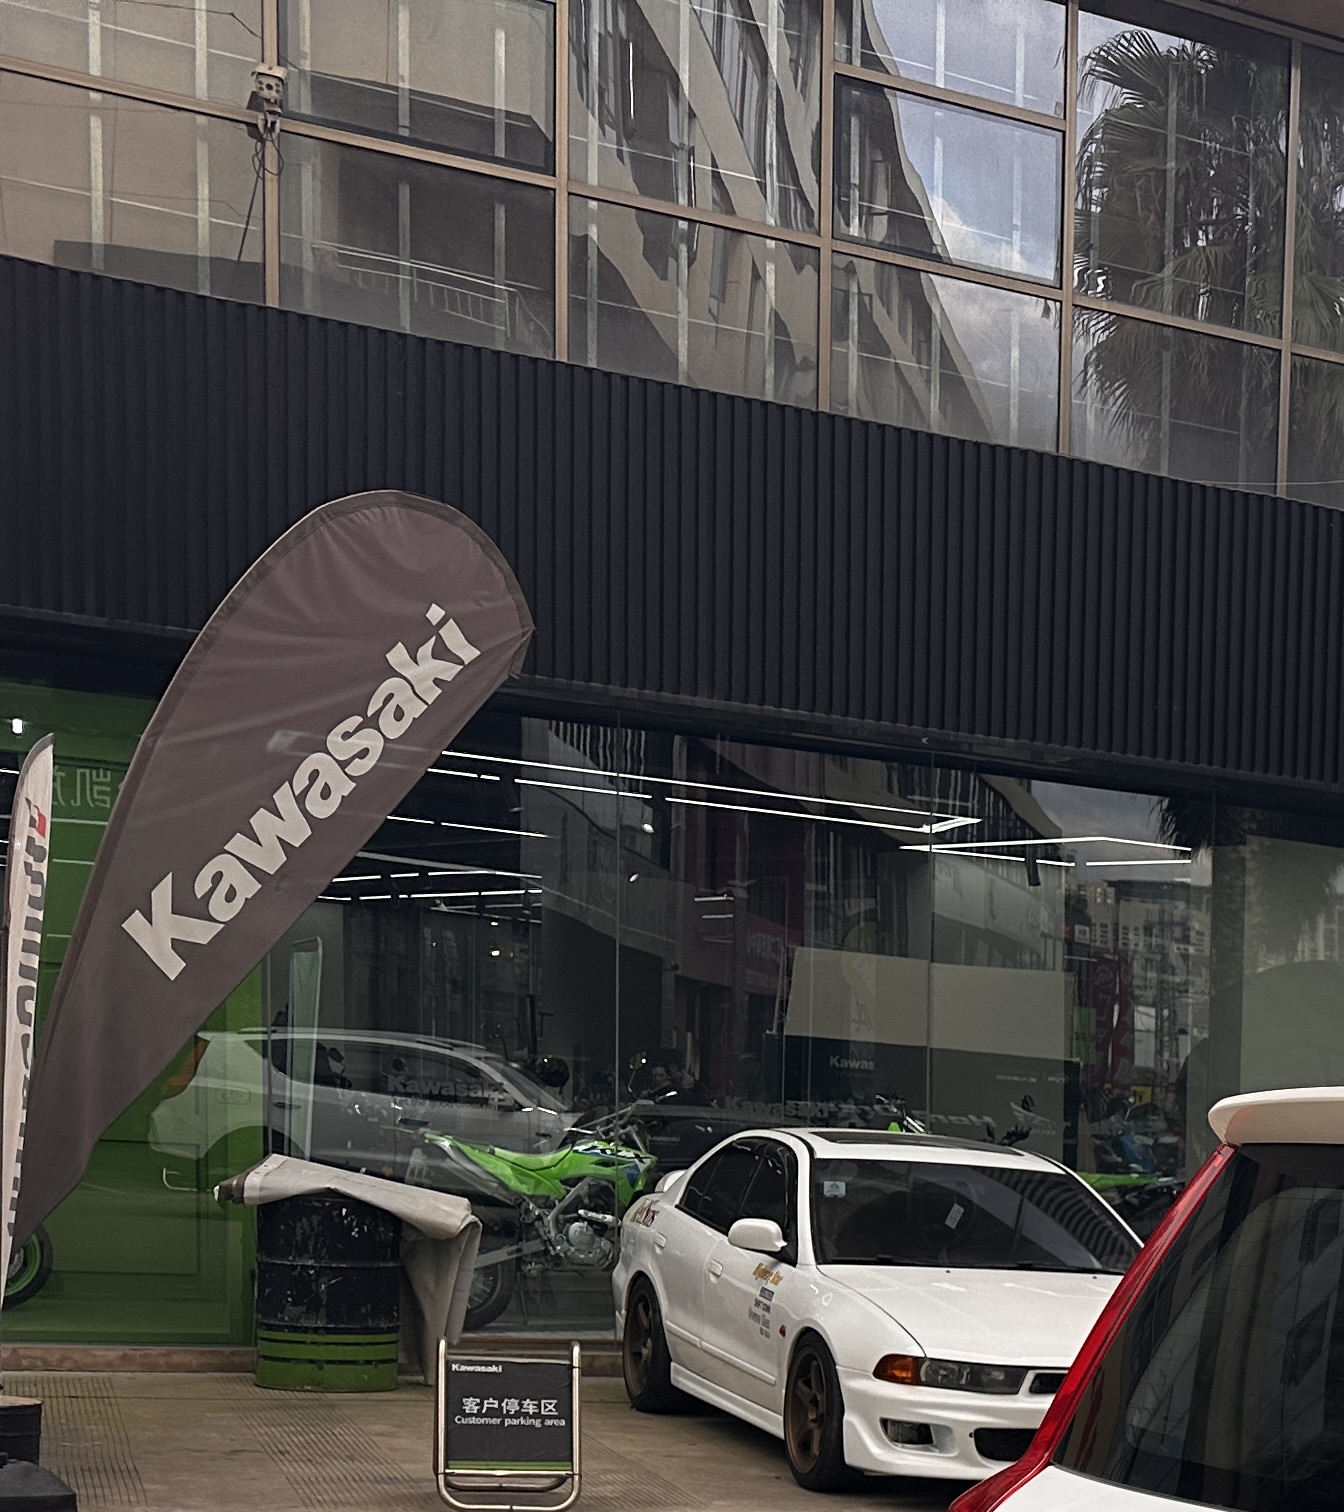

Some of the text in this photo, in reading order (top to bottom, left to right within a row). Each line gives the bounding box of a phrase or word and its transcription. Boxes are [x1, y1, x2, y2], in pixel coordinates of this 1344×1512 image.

[121, 603, 482, 981] Kawasaki
[451, 1363, 503, 1373] Kawasaki
[462, 1396, 559, 1416] 客户停车区
[454, 1415, 502, 1426] Customer
[504, 1416, 543, 1428] parking
